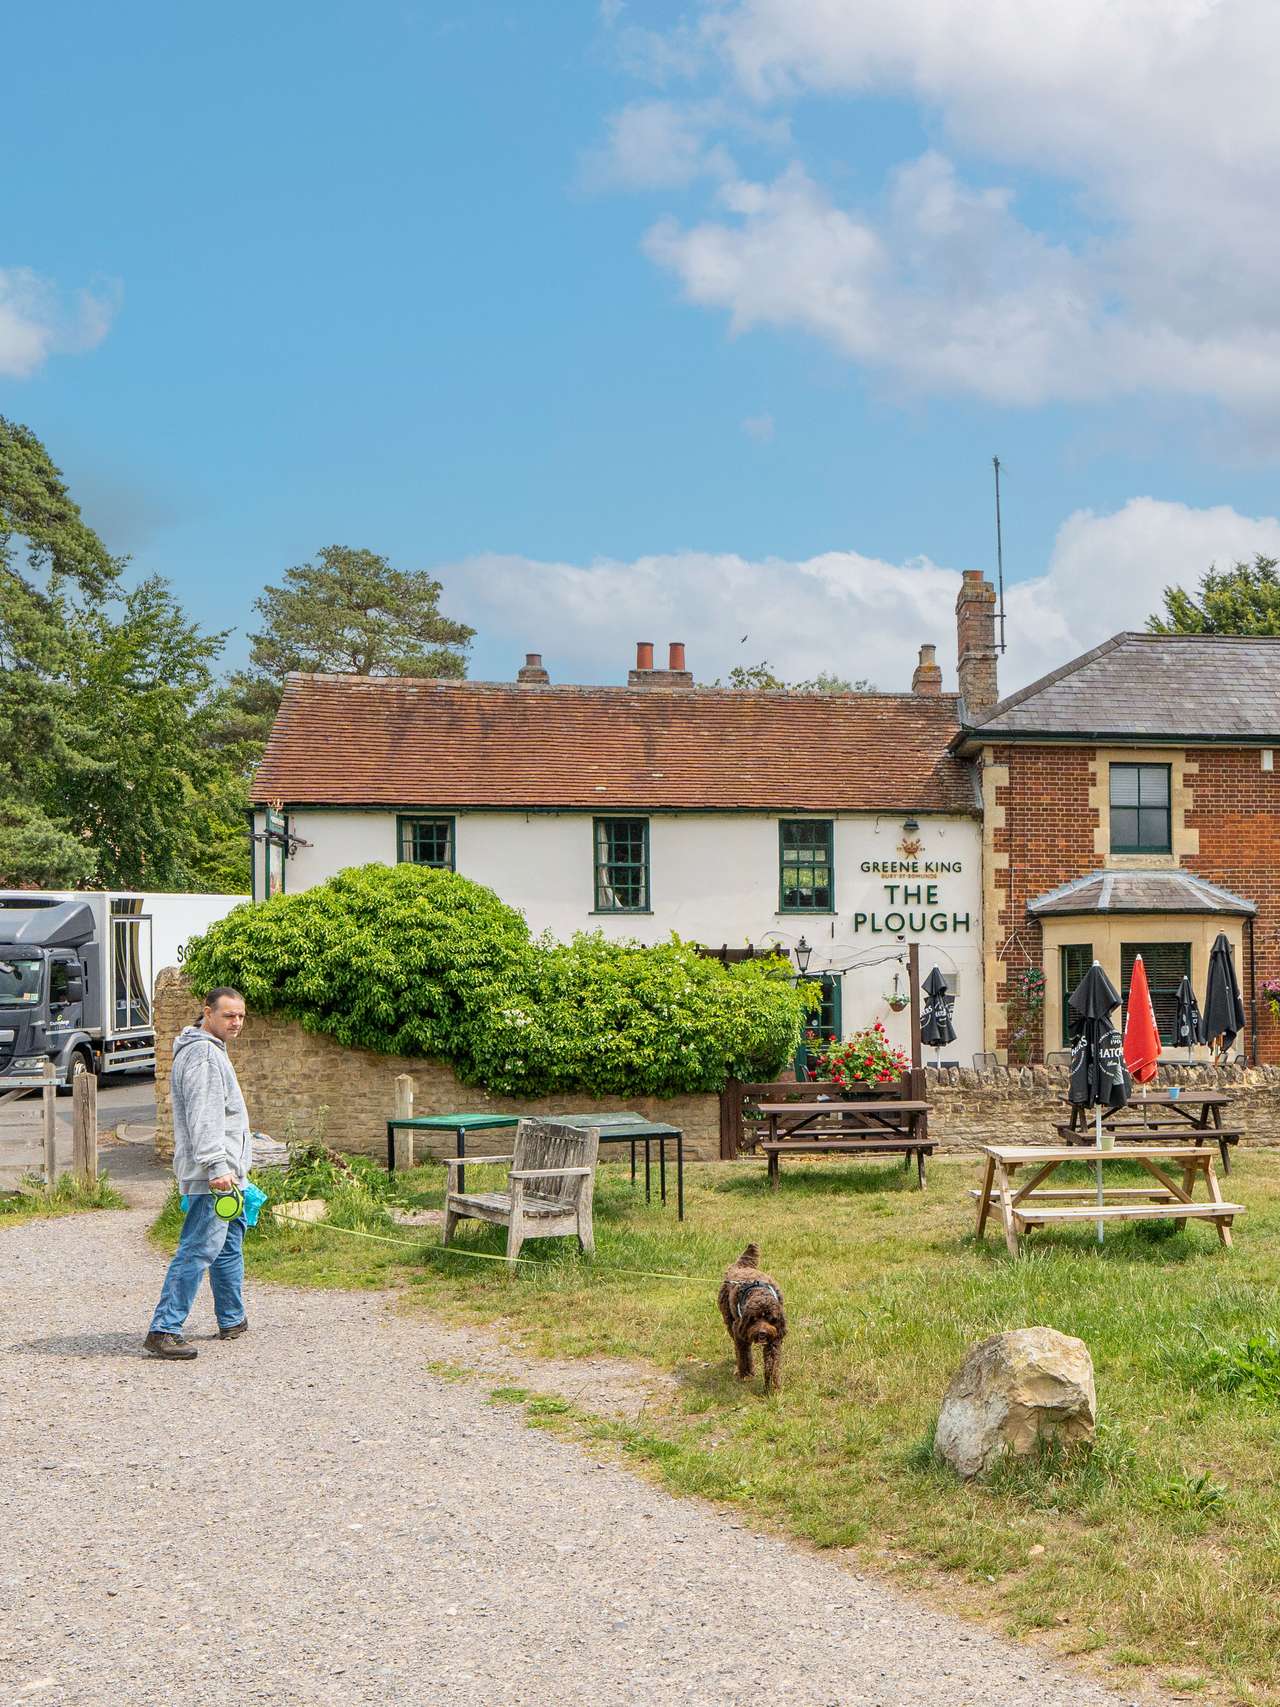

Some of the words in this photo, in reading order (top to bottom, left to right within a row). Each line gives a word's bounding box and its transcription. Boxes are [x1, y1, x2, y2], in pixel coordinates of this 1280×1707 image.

[860, 861, 919, 873] GREENE
[925, 861, 962, 873] KING
[884, 885, 938, 905] THE
[854, 912, 970, 933] PLOUGH
